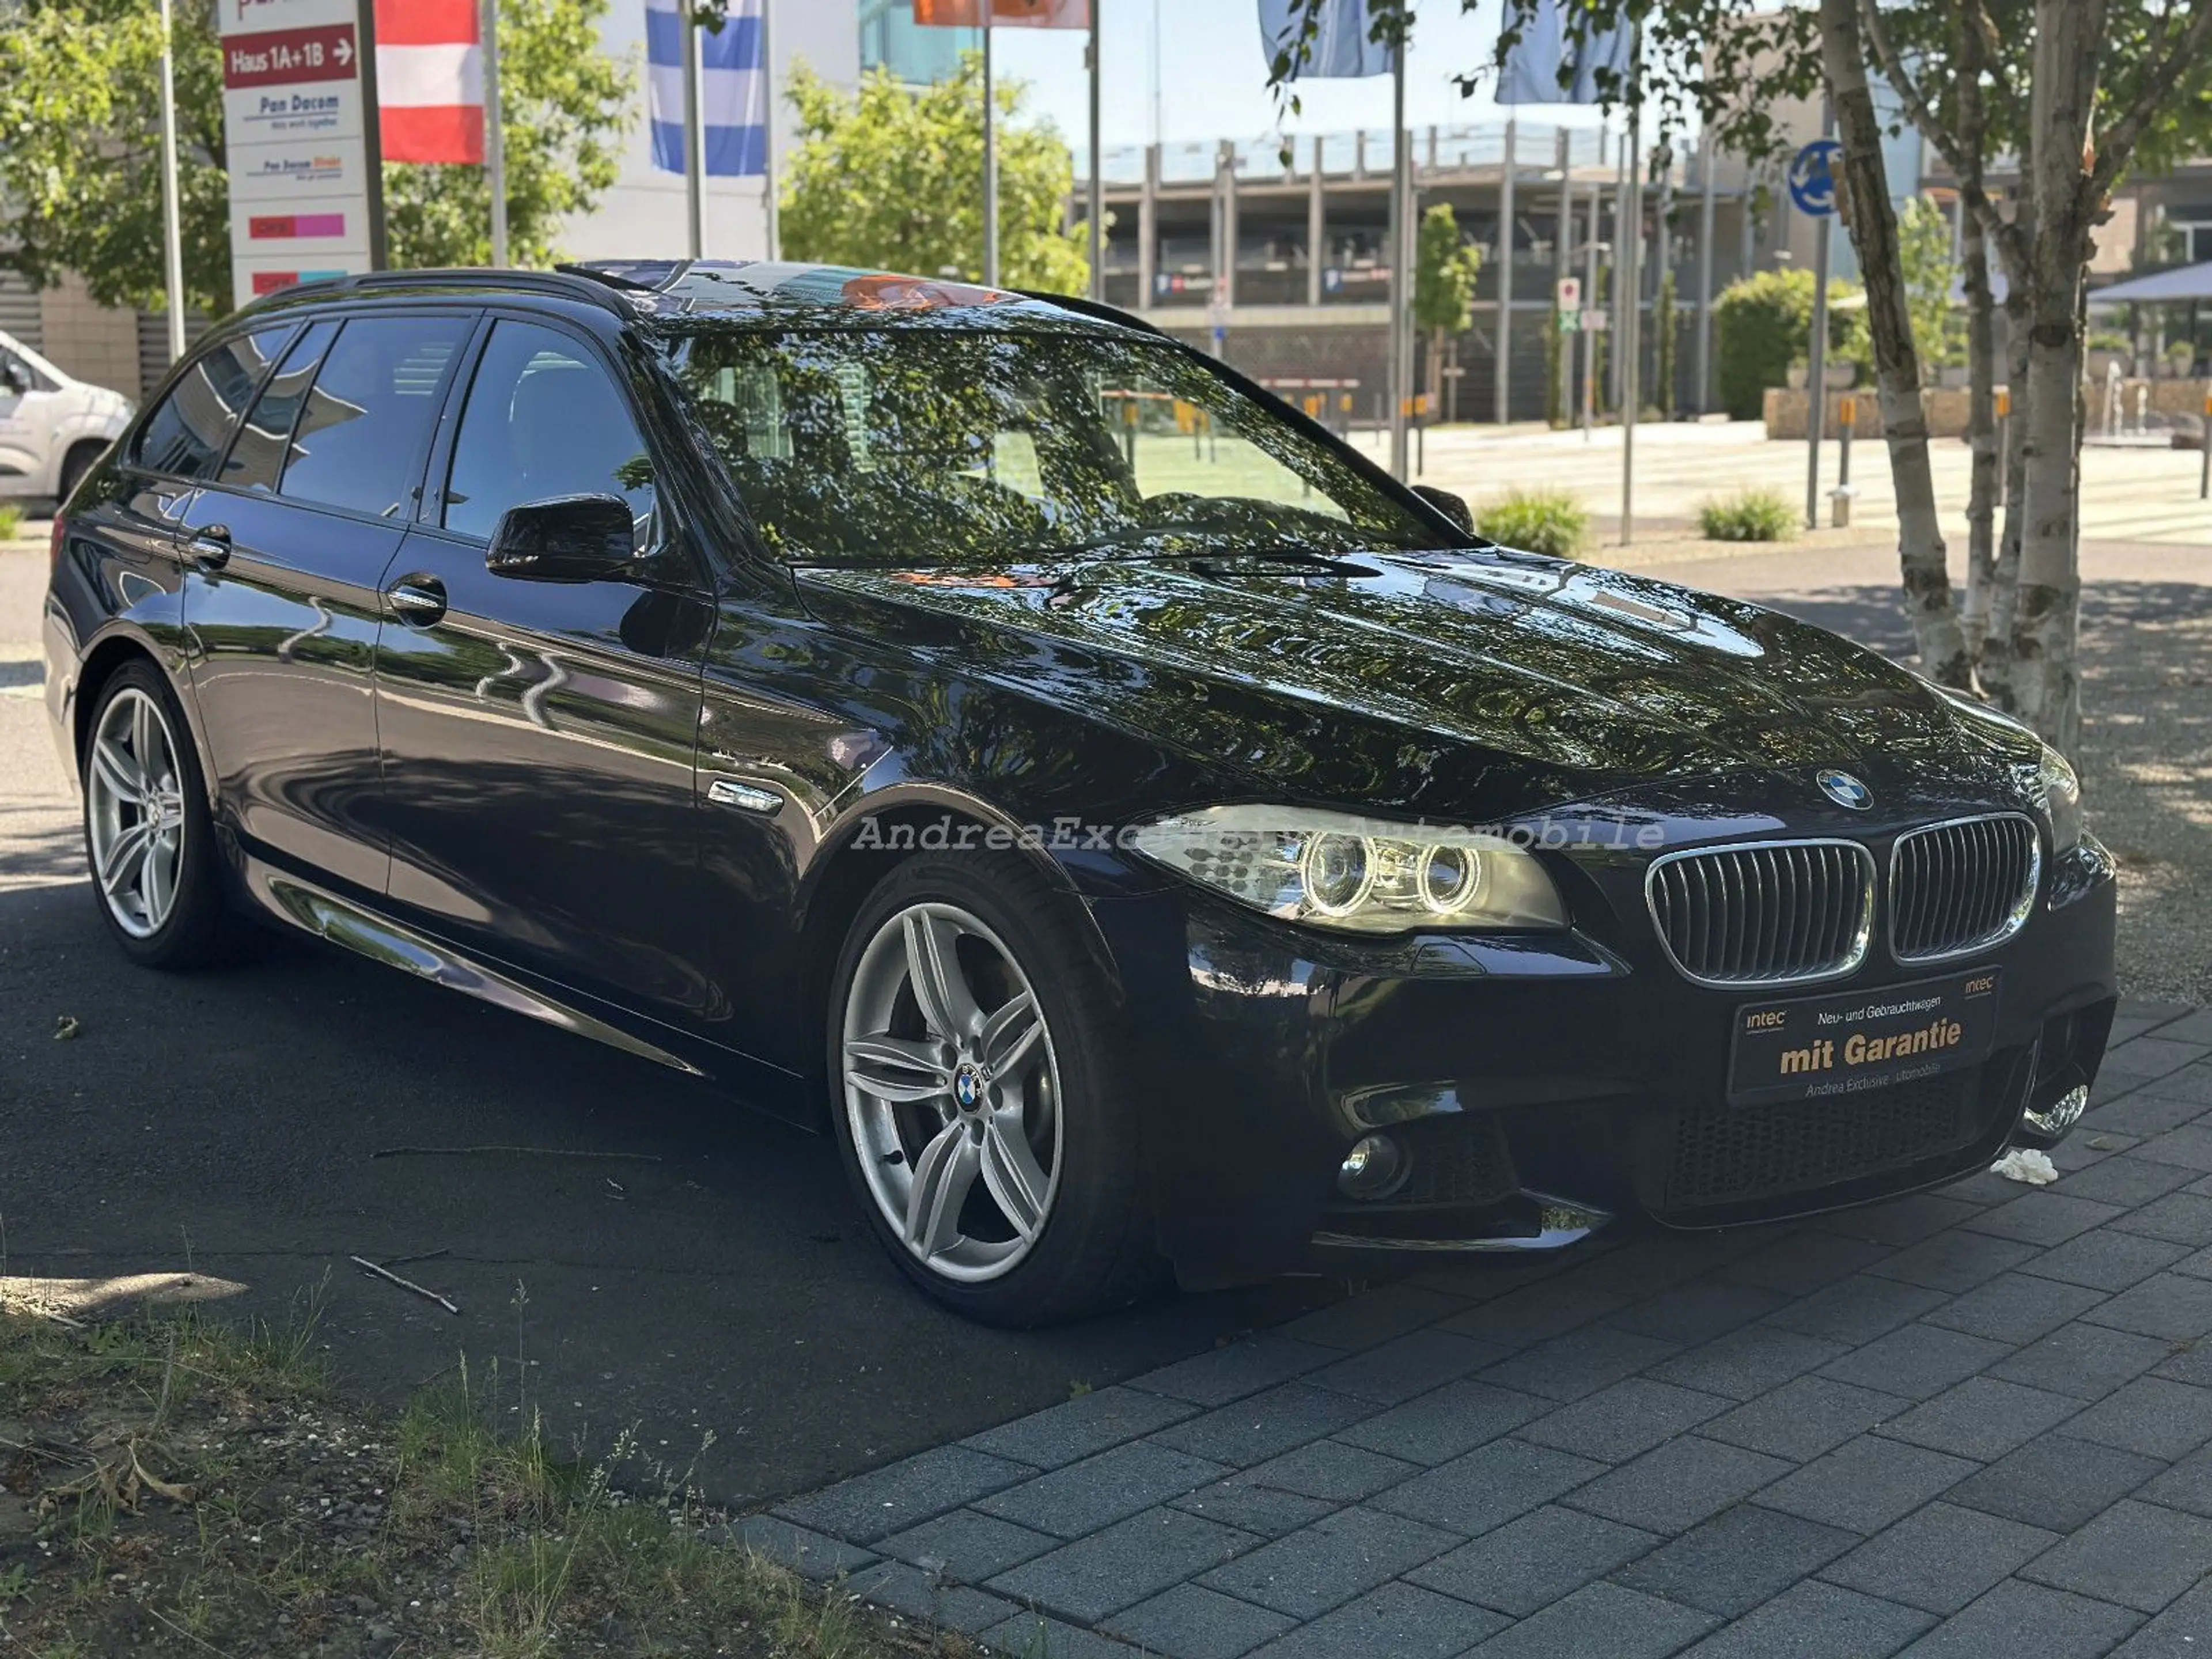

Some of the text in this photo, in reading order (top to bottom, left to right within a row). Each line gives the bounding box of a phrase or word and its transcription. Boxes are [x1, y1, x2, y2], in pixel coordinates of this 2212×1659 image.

[231, 48, 268, 74] Haus
[260, 96, 287, 113] Pan
[1845, 1007, 1865, 1021] und
[1780, 1017, 1961, 1074] mit Garantie
[1805, 1064, 1941, 1096] Andrea Exclusive utomobile
